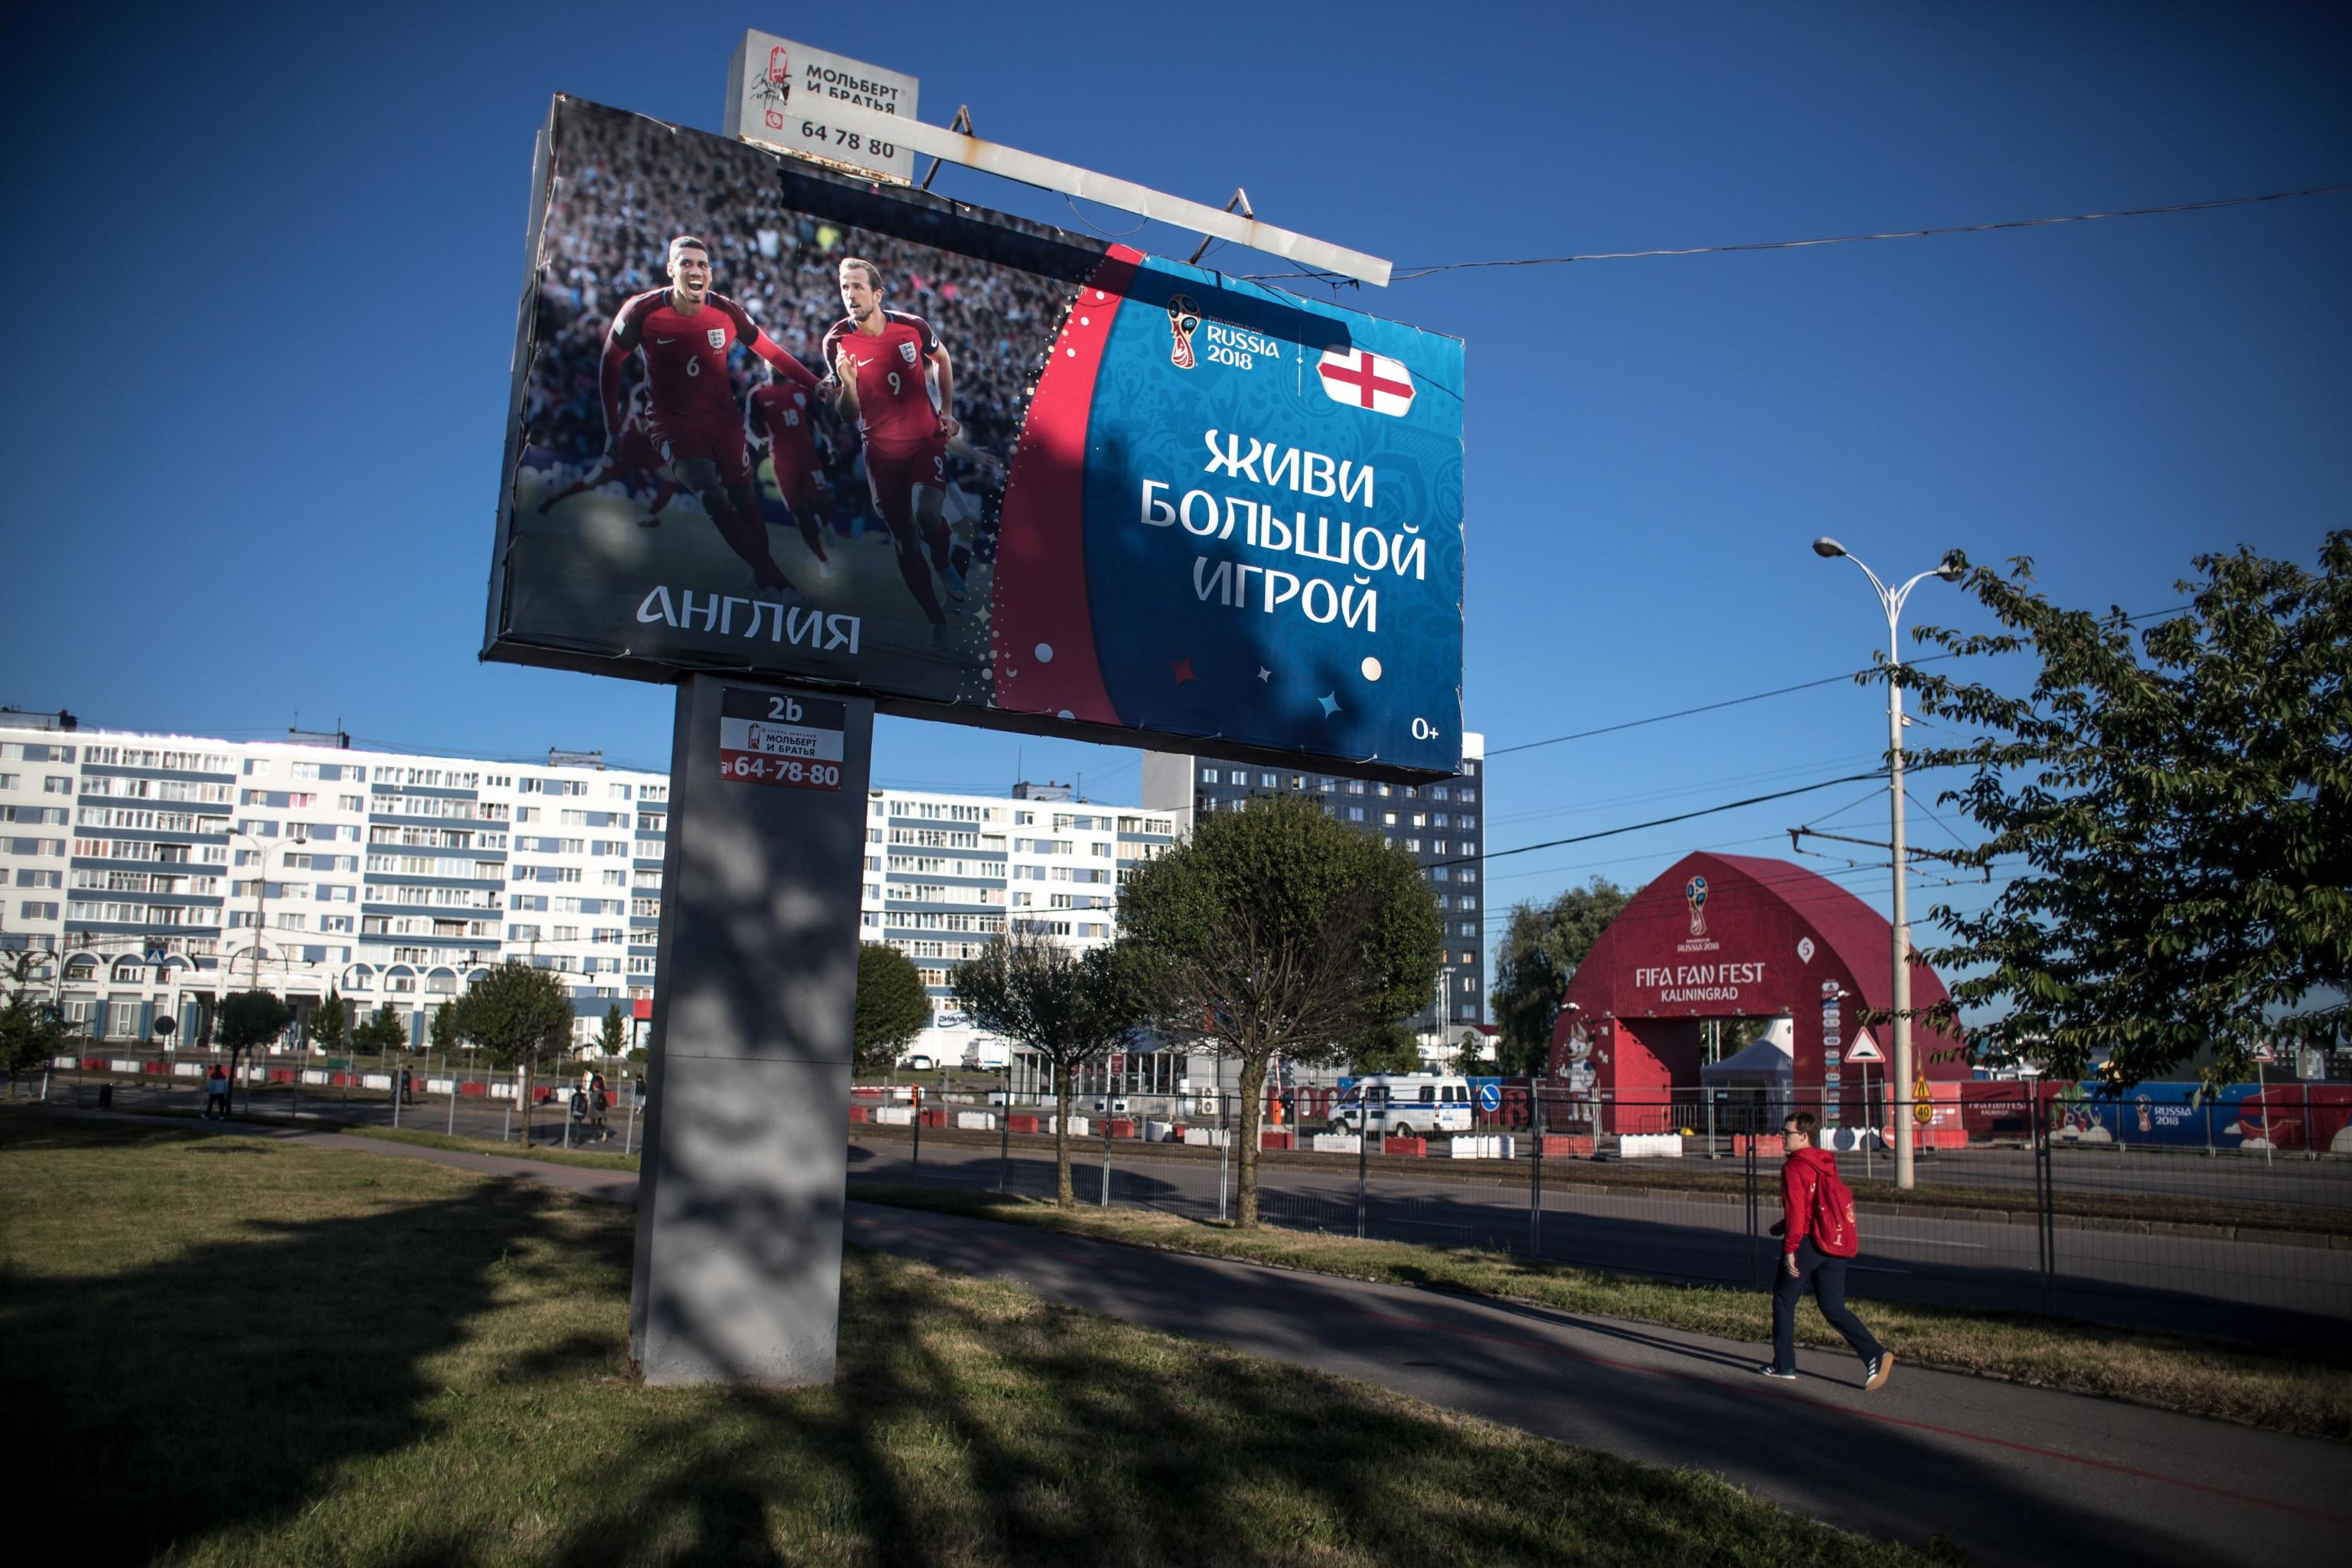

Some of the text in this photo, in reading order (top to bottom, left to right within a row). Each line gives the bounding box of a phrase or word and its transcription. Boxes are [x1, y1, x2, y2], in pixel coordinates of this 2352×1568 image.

[806, 64, 899, 100] МОЛЬБЕРТ
[807, 80, 821, 93] И
[828, 87, 895, 115] БРАТЬЯ
[802, 121, 894, 158] 64 78 80
[1207, 325, 1279, 359] RUSSIA
[687, 355, 700, 377] 6
[1207, 345, 1253, 370] 2018
[887, 372, 900, 395] 9
[782, 408, 799, 426] 18
[1204, 429, 1374, 508] ЖИВИ
[1141, 479, 1426, 580] БОЛЬШОЙ
[1193, 556, 1377, 632] ИГРОЙ
[636, 585, 861, 655] АНГЛИЯ
[768, 697, 802, 722] 2b
[766, 734, 817, 747] МОЛЬБЕРТ
[1411, 717, 1439, 740] 0+
[766, 743, 815, 756] И БРАТЬЯ
[734, 756, 839, 786] 64-78-80
[1677, 942, 1720, 952] RUSSIA 2018
[1802, 942, 1810, 956] 5
[1636, 962, 1766, 988] FIFA FAN FEST
[1661, 987, 1738, 1002] KALININGRAD
[1918, 1106, 1929, 1116] 40
[2154, 1106, 2193, 1116] RUSSIA
[2155, 1116, 2179, 1125] 2018
